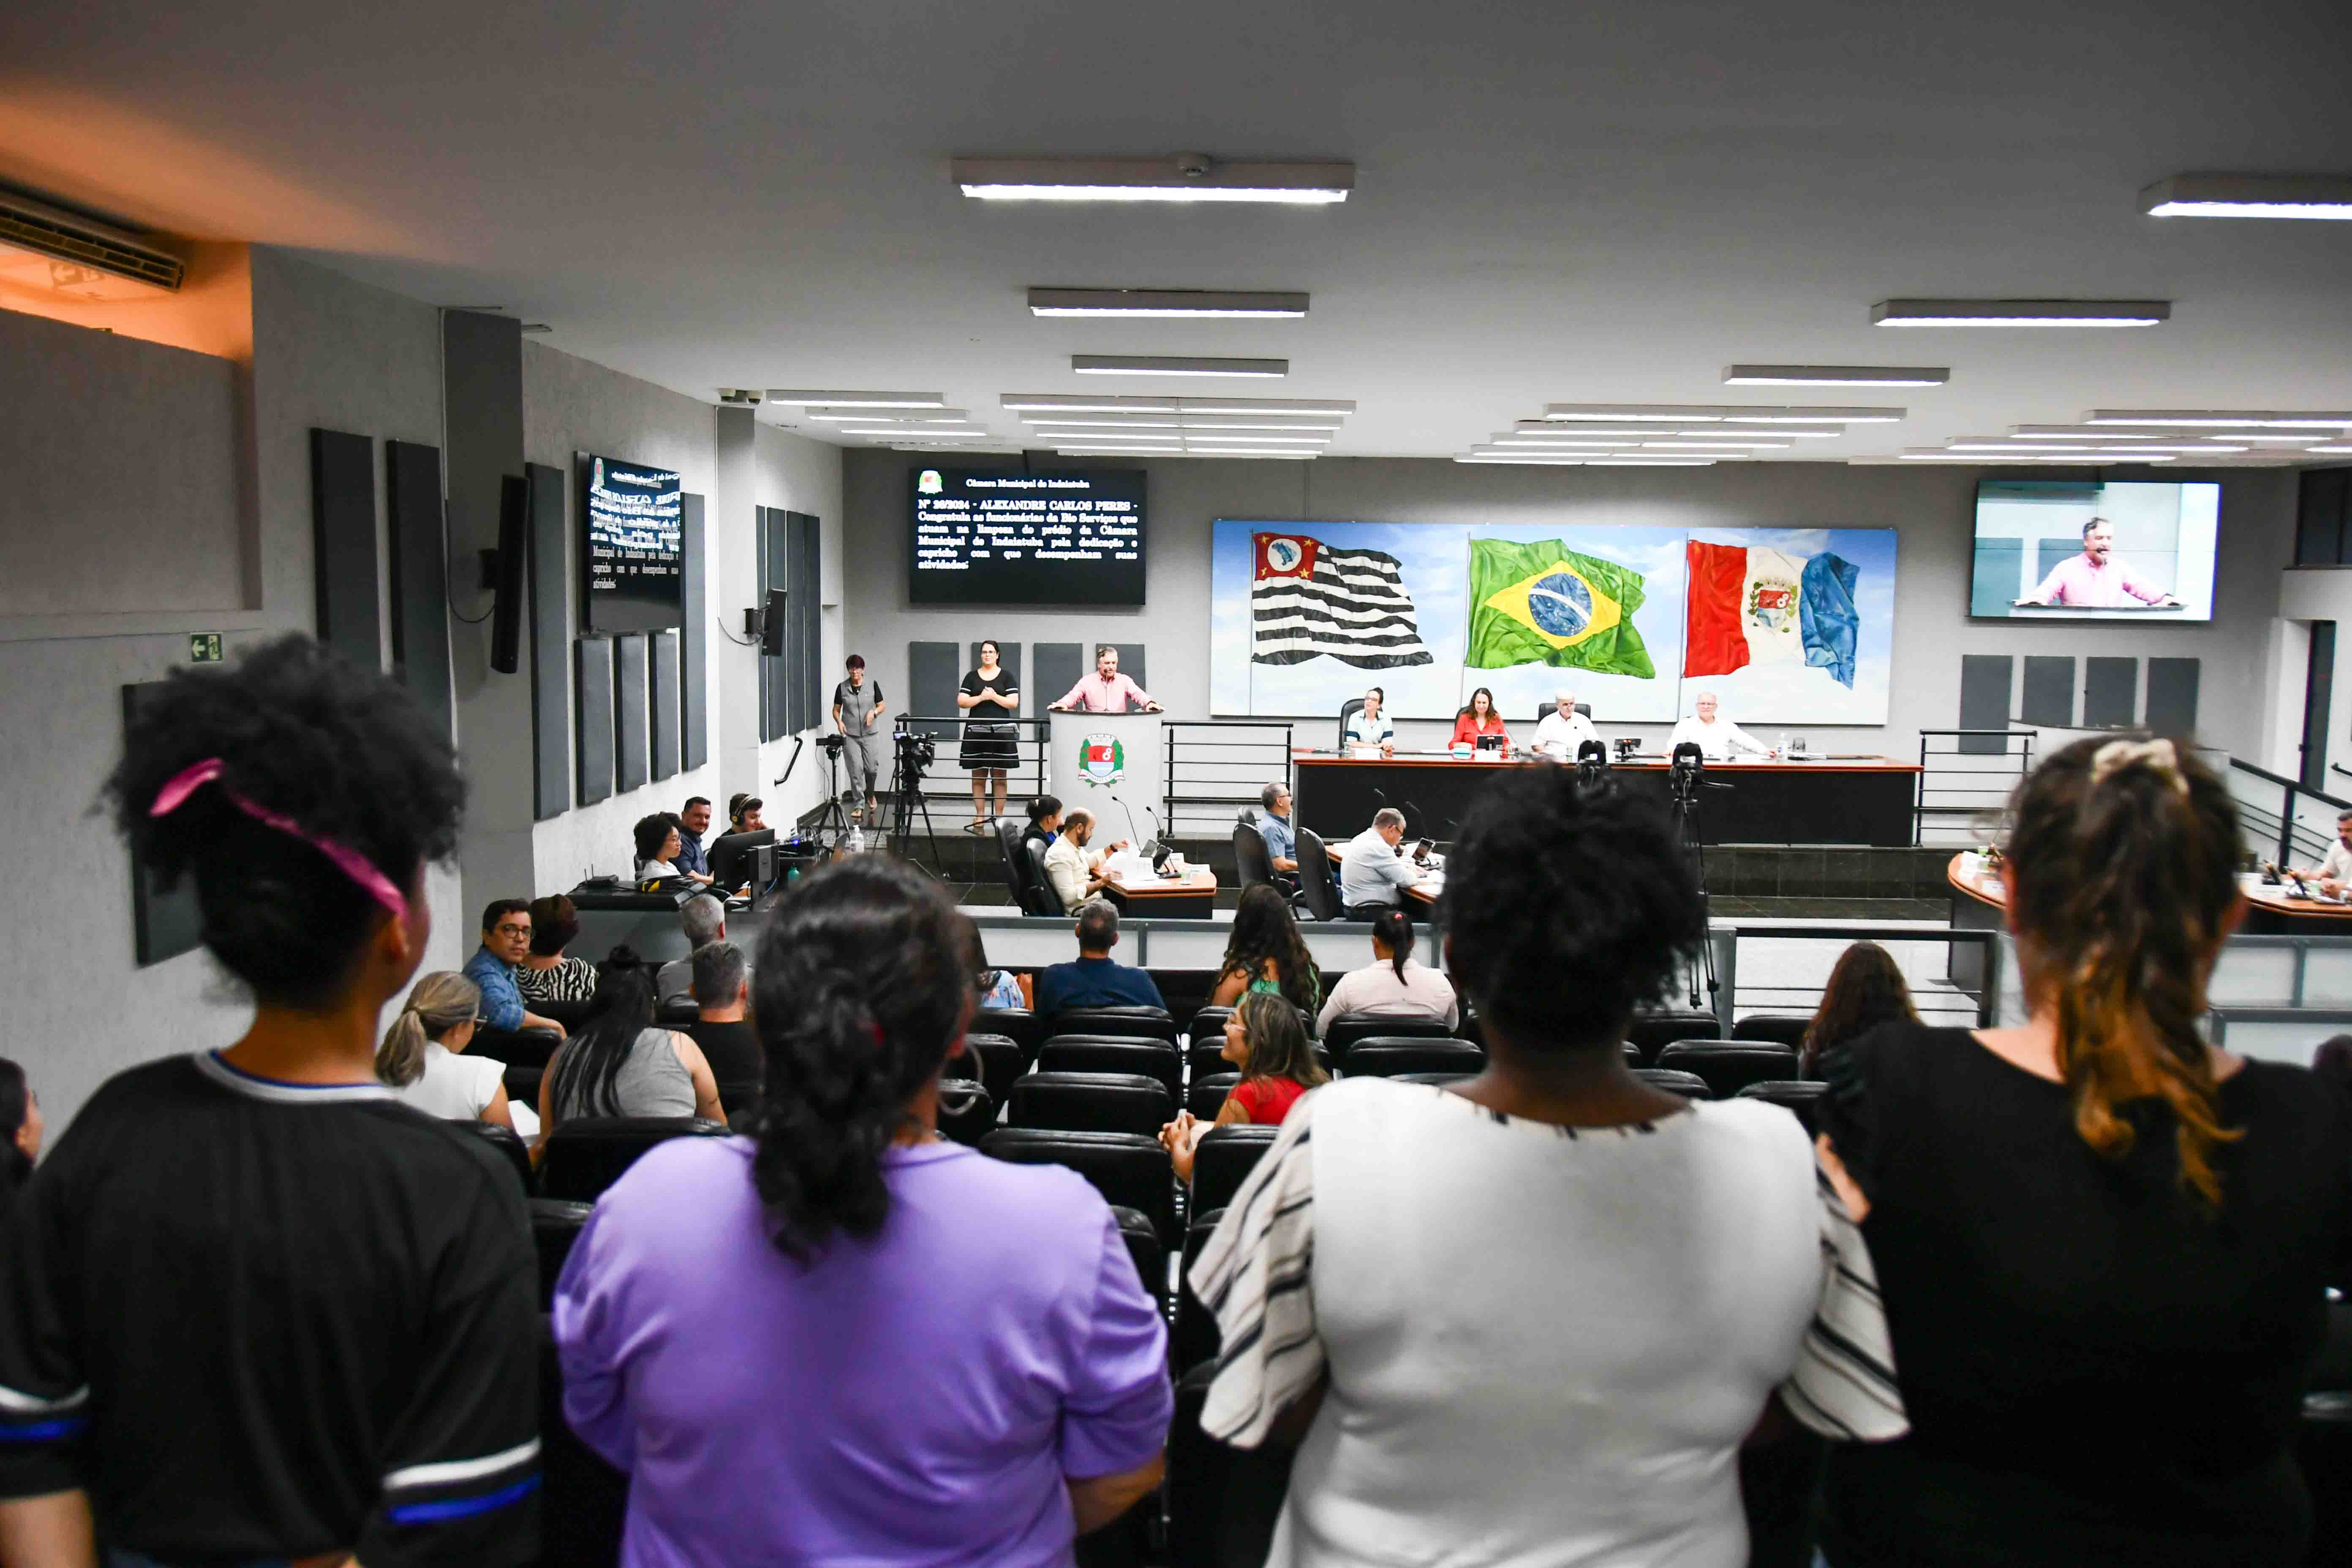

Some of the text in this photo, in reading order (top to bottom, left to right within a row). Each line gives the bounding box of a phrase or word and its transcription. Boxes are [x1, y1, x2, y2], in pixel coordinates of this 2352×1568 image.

[997, 479, 1037, 489] Municipal
[1037, 479, 1047, 488] de
[1048, 479, 1090, 488] Indaiatuba
[979, 500, 1046, 510] ALEXANDRE
[1049, 500, 1092, 511] CARLOS
[1095, 501, 1131, 511] PERES
[918, 511, 1138, 525] Congratula as funcionárias da Bio Serviços que
[918, 524, 949, 533] atuam
[977, 524, 1014, 536] limpeza
[1021, 524, 1034, 534] do
[1041, 525, 1072, 536] prédio
[1079, 525, 1092, 535] da
[1100, 525, 1138, 535] Câmara
[918, 535, 966, 547] Municipal
[972, 536, 985, 545] de
[991, 536, 1044, 546] Indaiatuba
[1051, 537, 1072, 548] pela
[1078, 537, 1124, 549] dedicação
[917, 547, 958, 559] capricho
[1003, 550, 1021, 560] que
[1035, 548, 1102, 561] desempenham
[1115, 552, 1138, 560] suas
